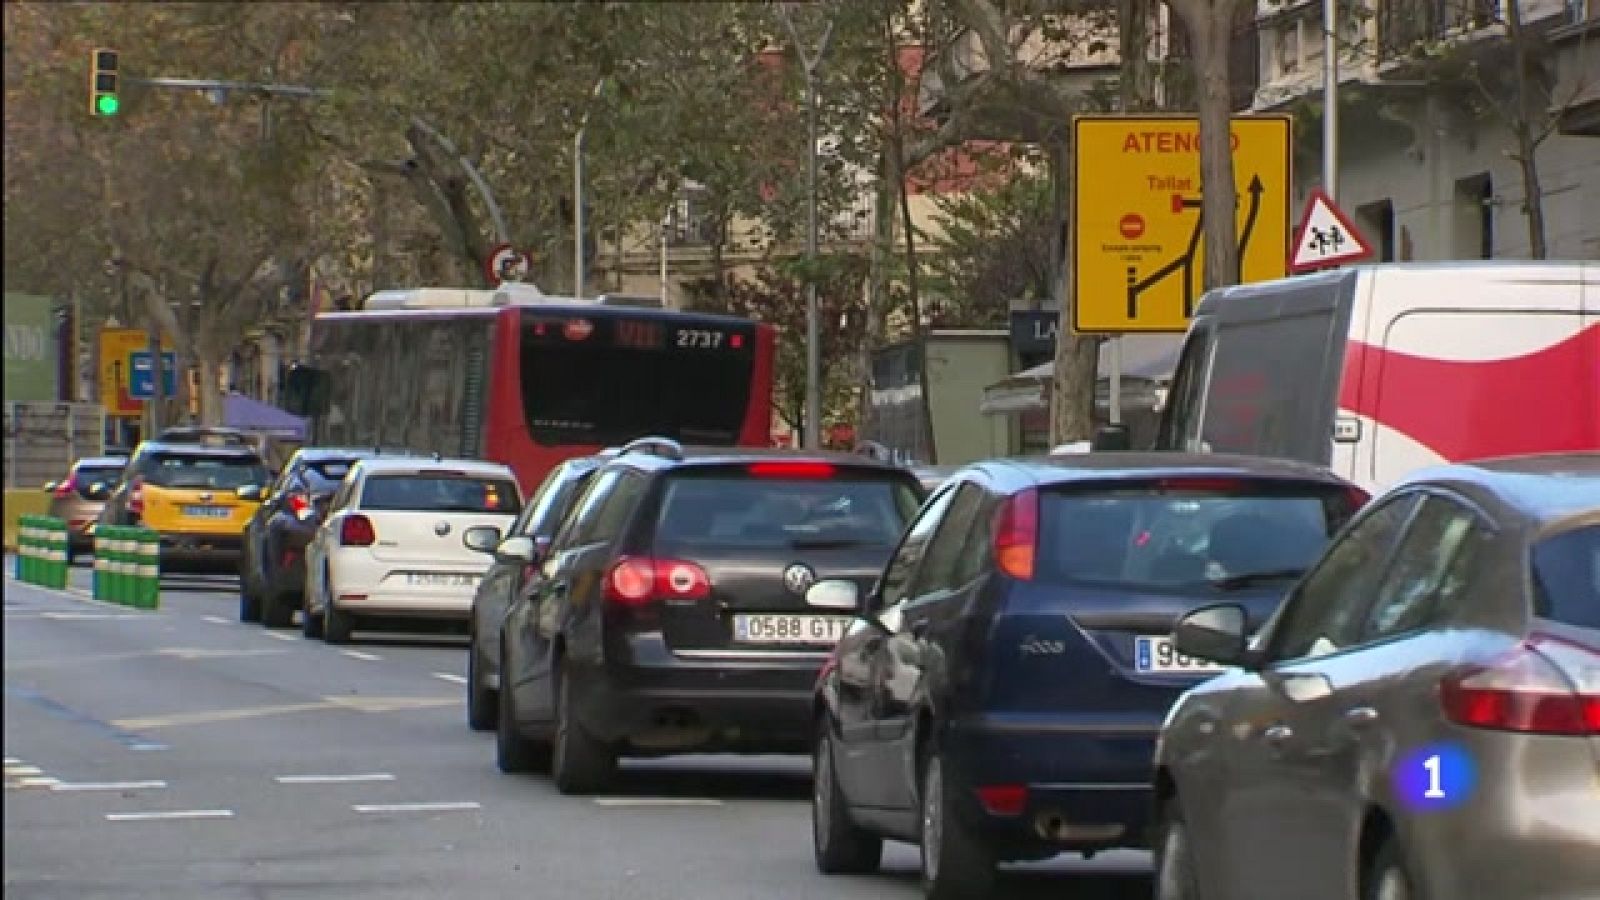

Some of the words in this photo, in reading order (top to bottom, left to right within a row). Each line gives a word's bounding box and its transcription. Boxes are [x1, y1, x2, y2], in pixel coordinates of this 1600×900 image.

[1147, 175, 1192, 191] Tallat
[677, 329, 723, 348] 2737
[749, 616, 801, 637] 0588
